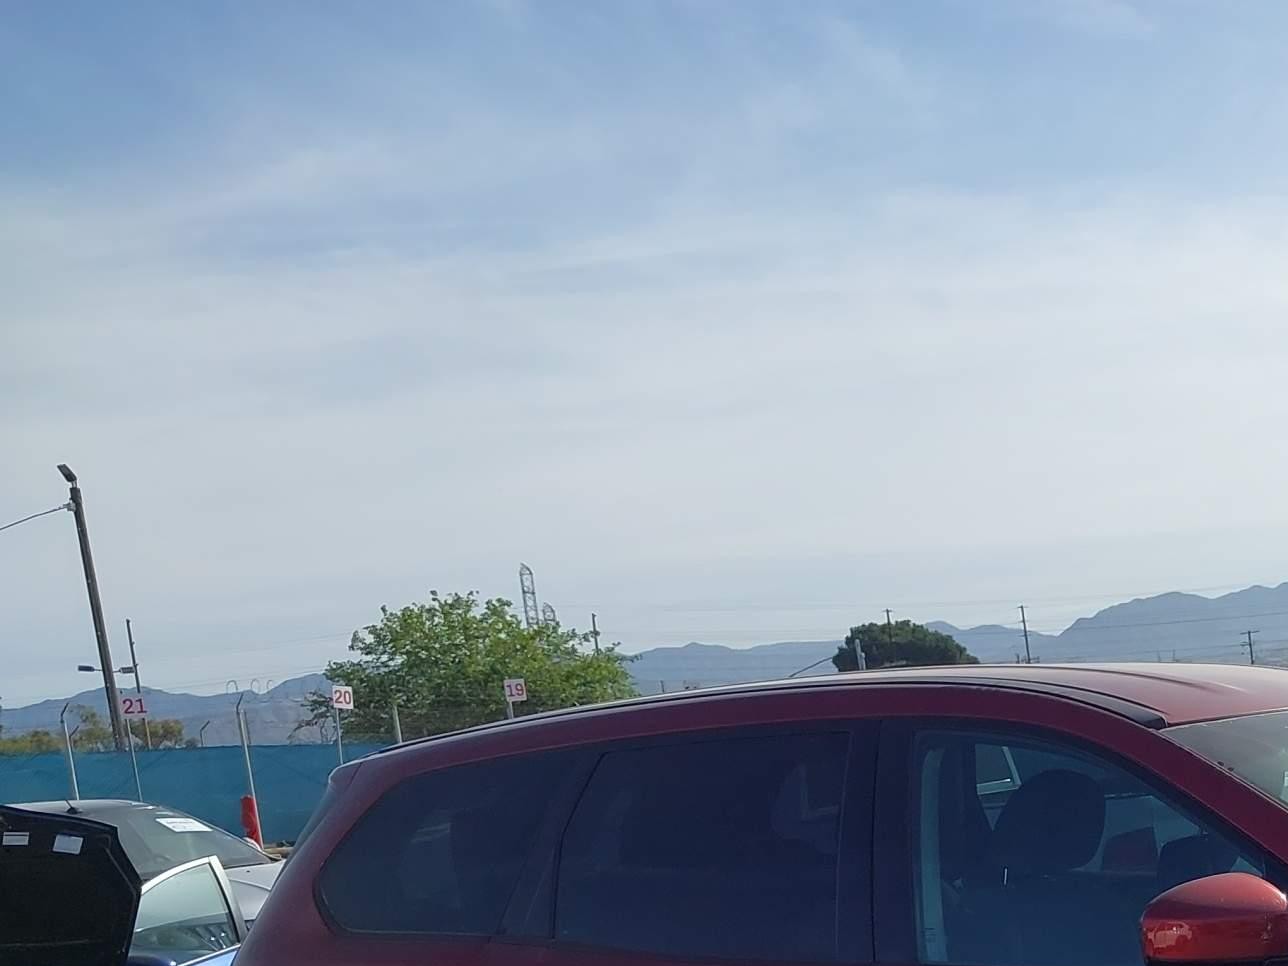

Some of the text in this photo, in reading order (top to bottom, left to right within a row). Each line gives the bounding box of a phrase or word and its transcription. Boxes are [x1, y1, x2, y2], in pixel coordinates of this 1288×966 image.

[334, 689, 352, 705] 20
[506, 683, 525, 698] 19
[123, 697, 147, 715] 21
